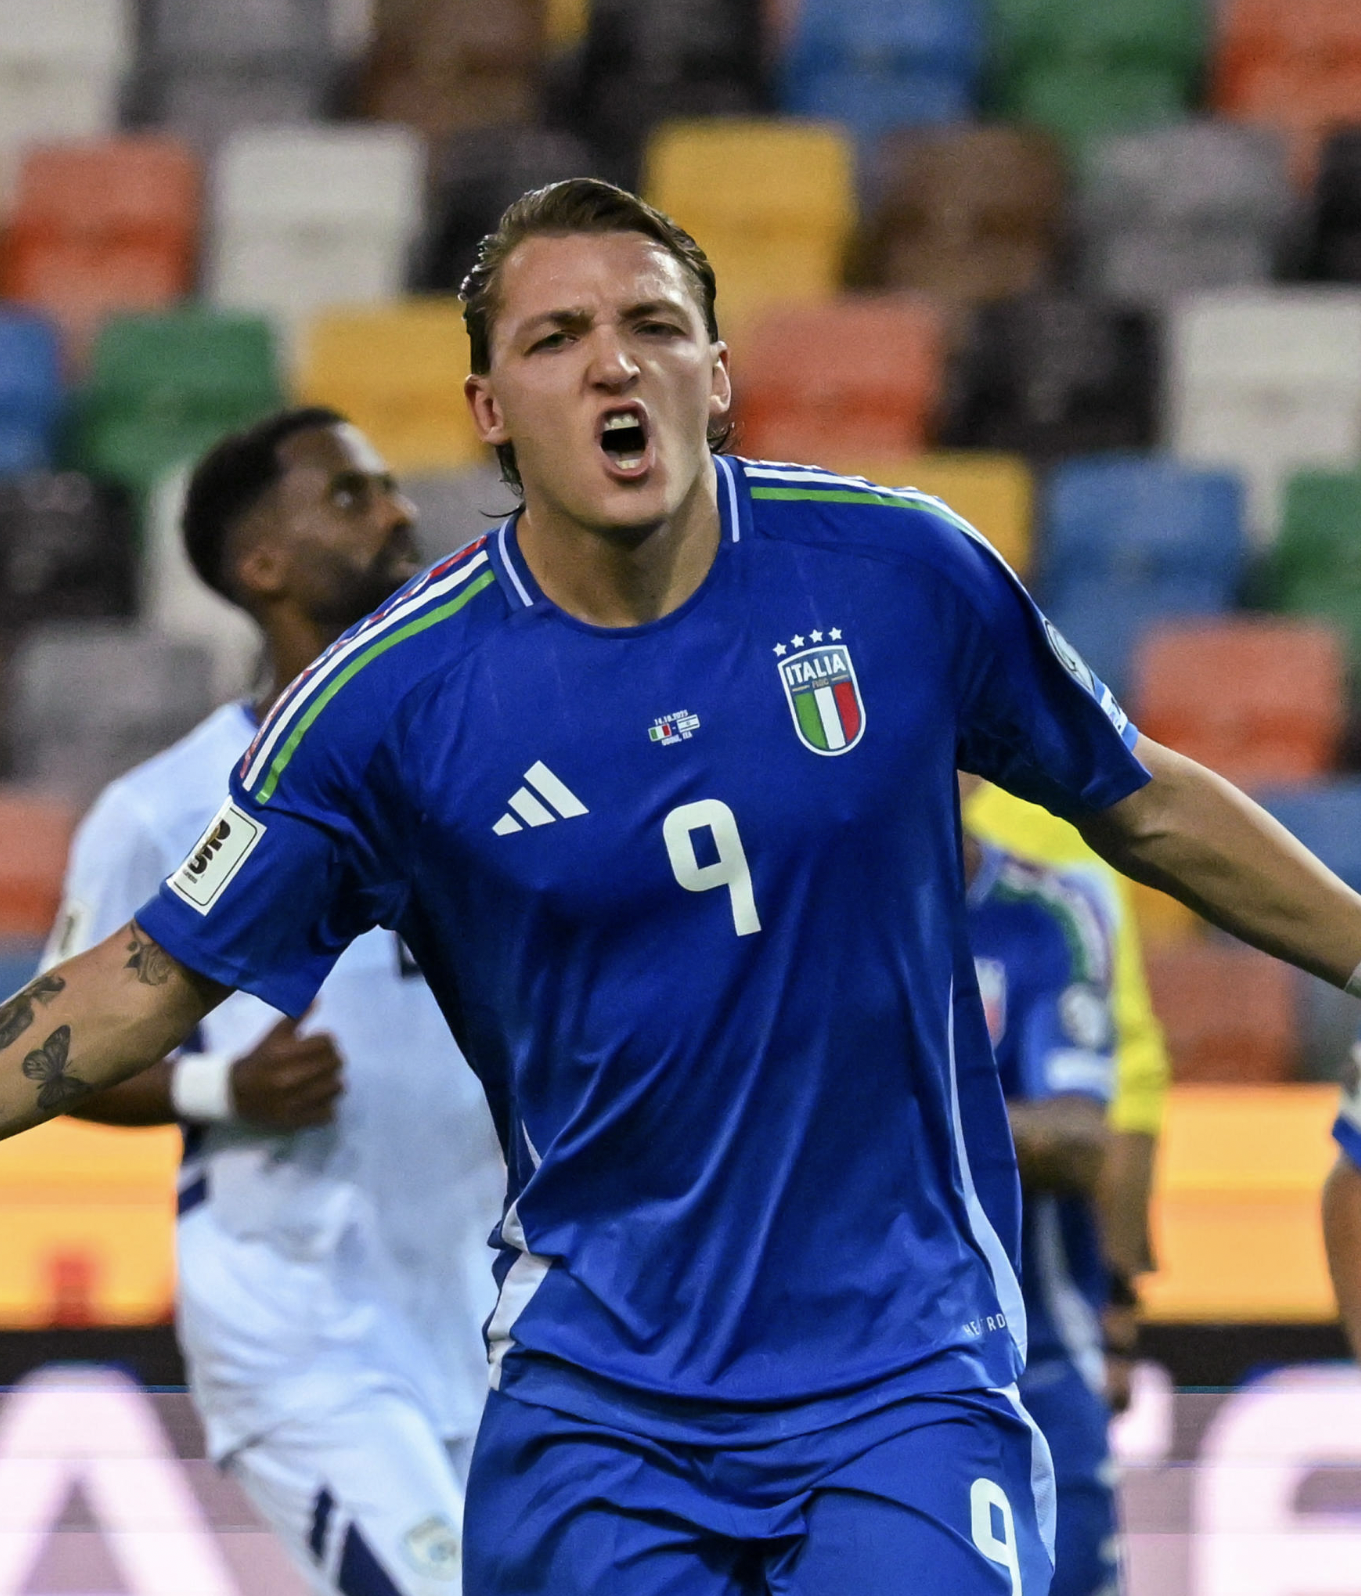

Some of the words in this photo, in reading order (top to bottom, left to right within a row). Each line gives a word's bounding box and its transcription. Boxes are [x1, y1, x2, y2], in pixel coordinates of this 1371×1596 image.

[785, 653, 847, 685] ITALIA
[663, 799, 762, 937] 9
[970, 1478, 1023, 1596] 9
